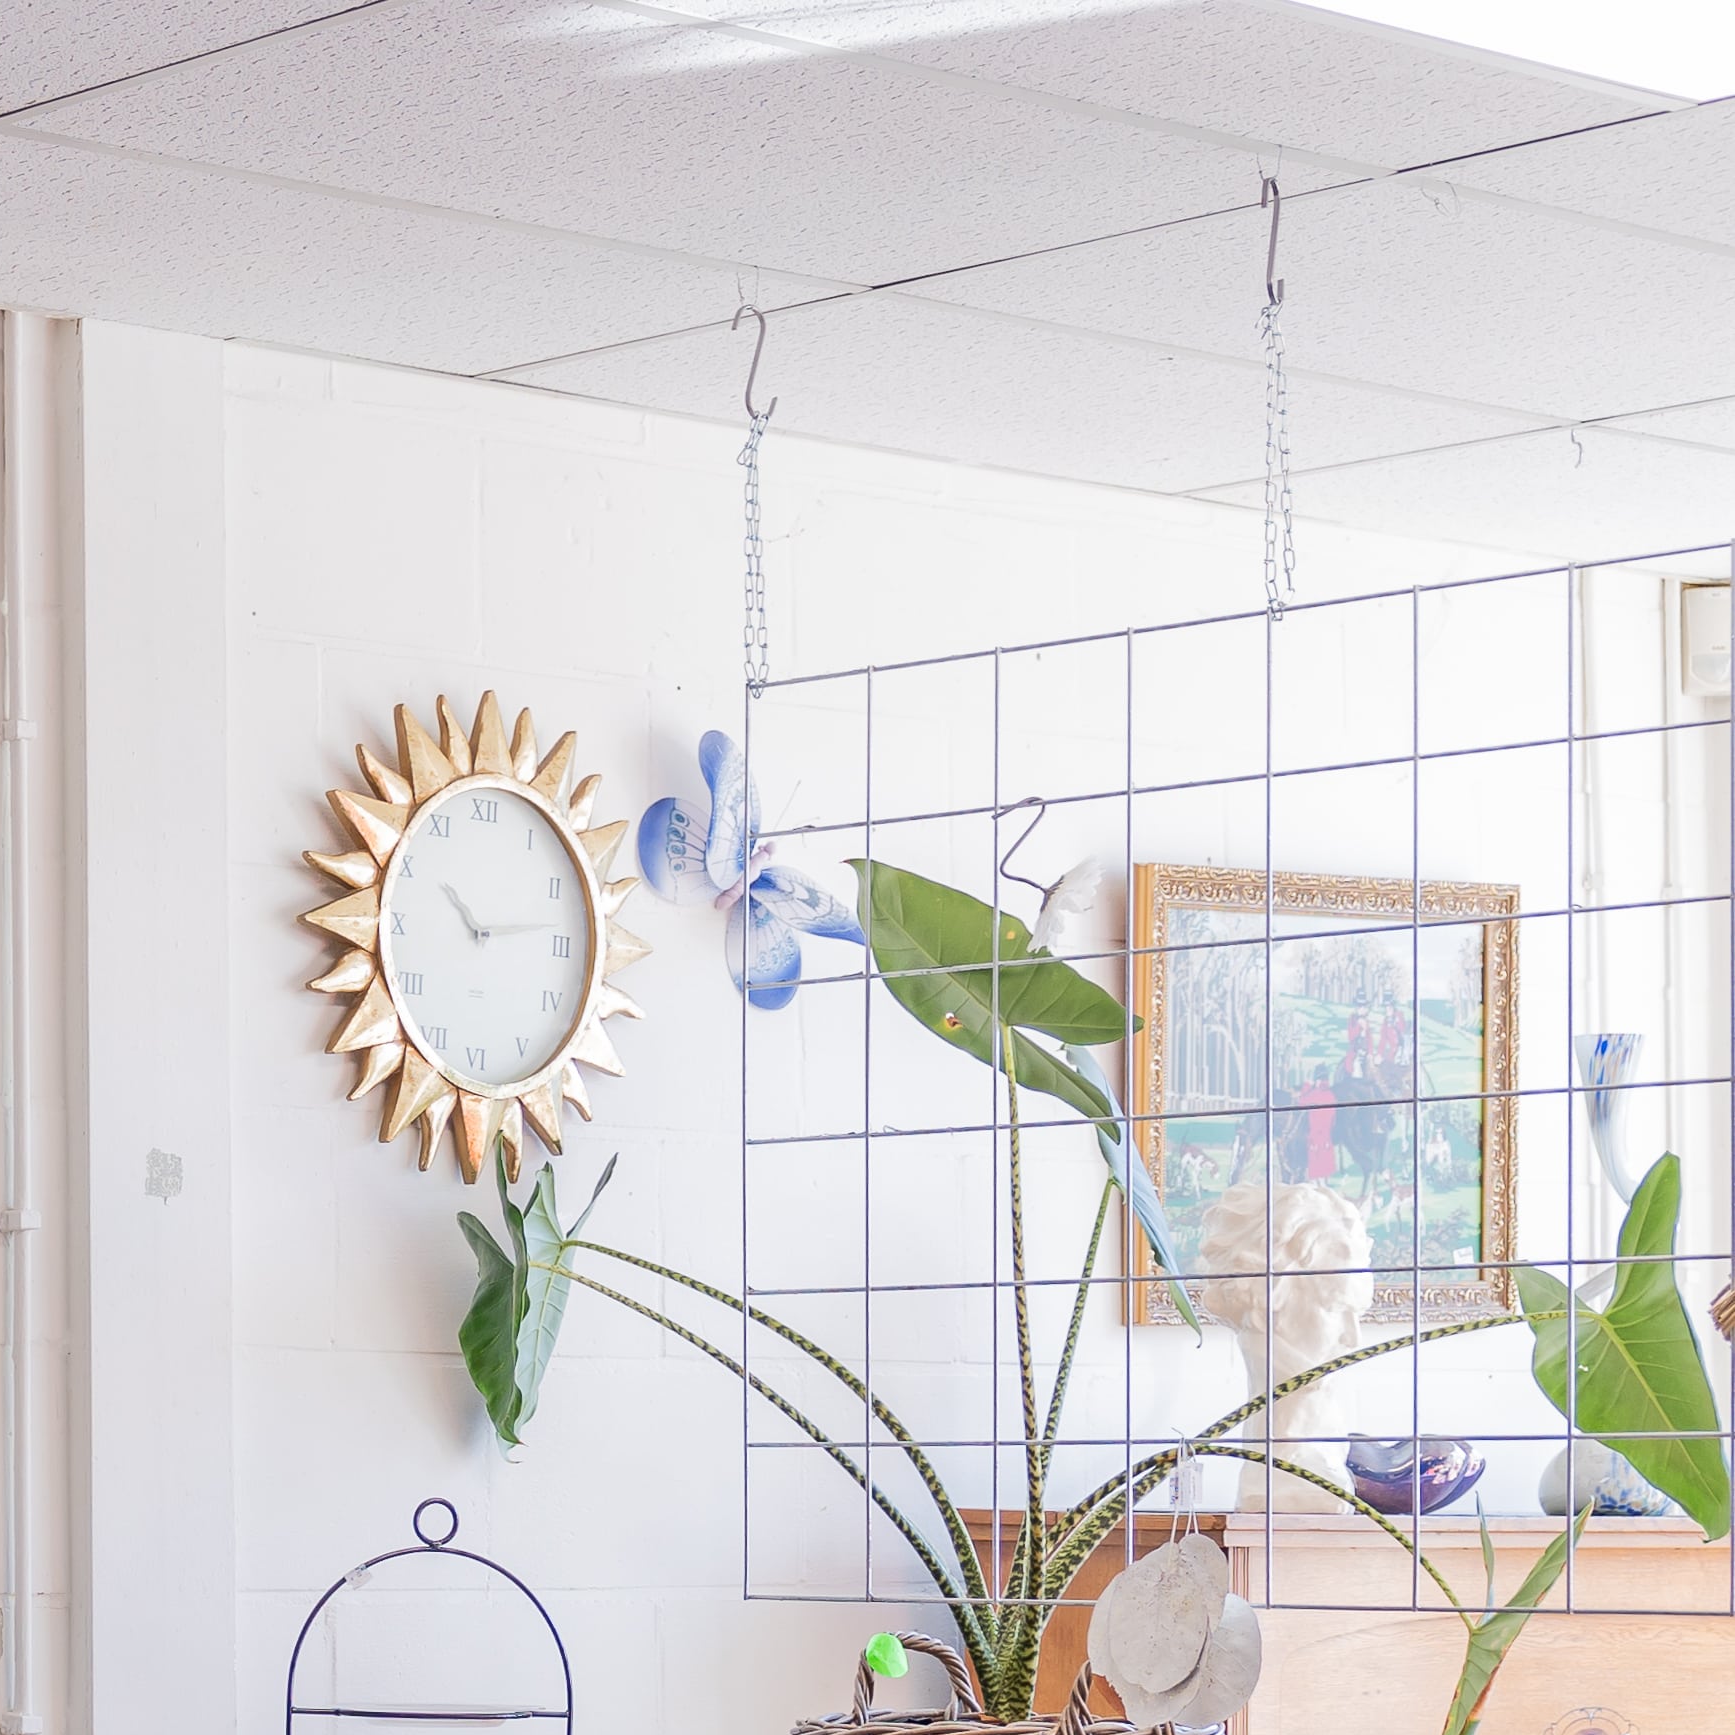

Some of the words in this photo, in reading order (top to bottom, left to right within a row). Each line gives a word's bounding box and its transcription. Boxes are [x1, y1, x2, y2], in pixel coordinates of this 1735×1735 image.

[471, 798, 498, 823] XII
[429, 814, 450, 838] XI
[527, 829, 533, 850] I
[399, 855, 414, 878] X
[549, 877, 561, 899] II
[552, 935, 570, 958] III
[542, 990, 563, 1012] IV
[466, 1047, 485, 1071] VI
[515, 1037, 529, 1059] V
